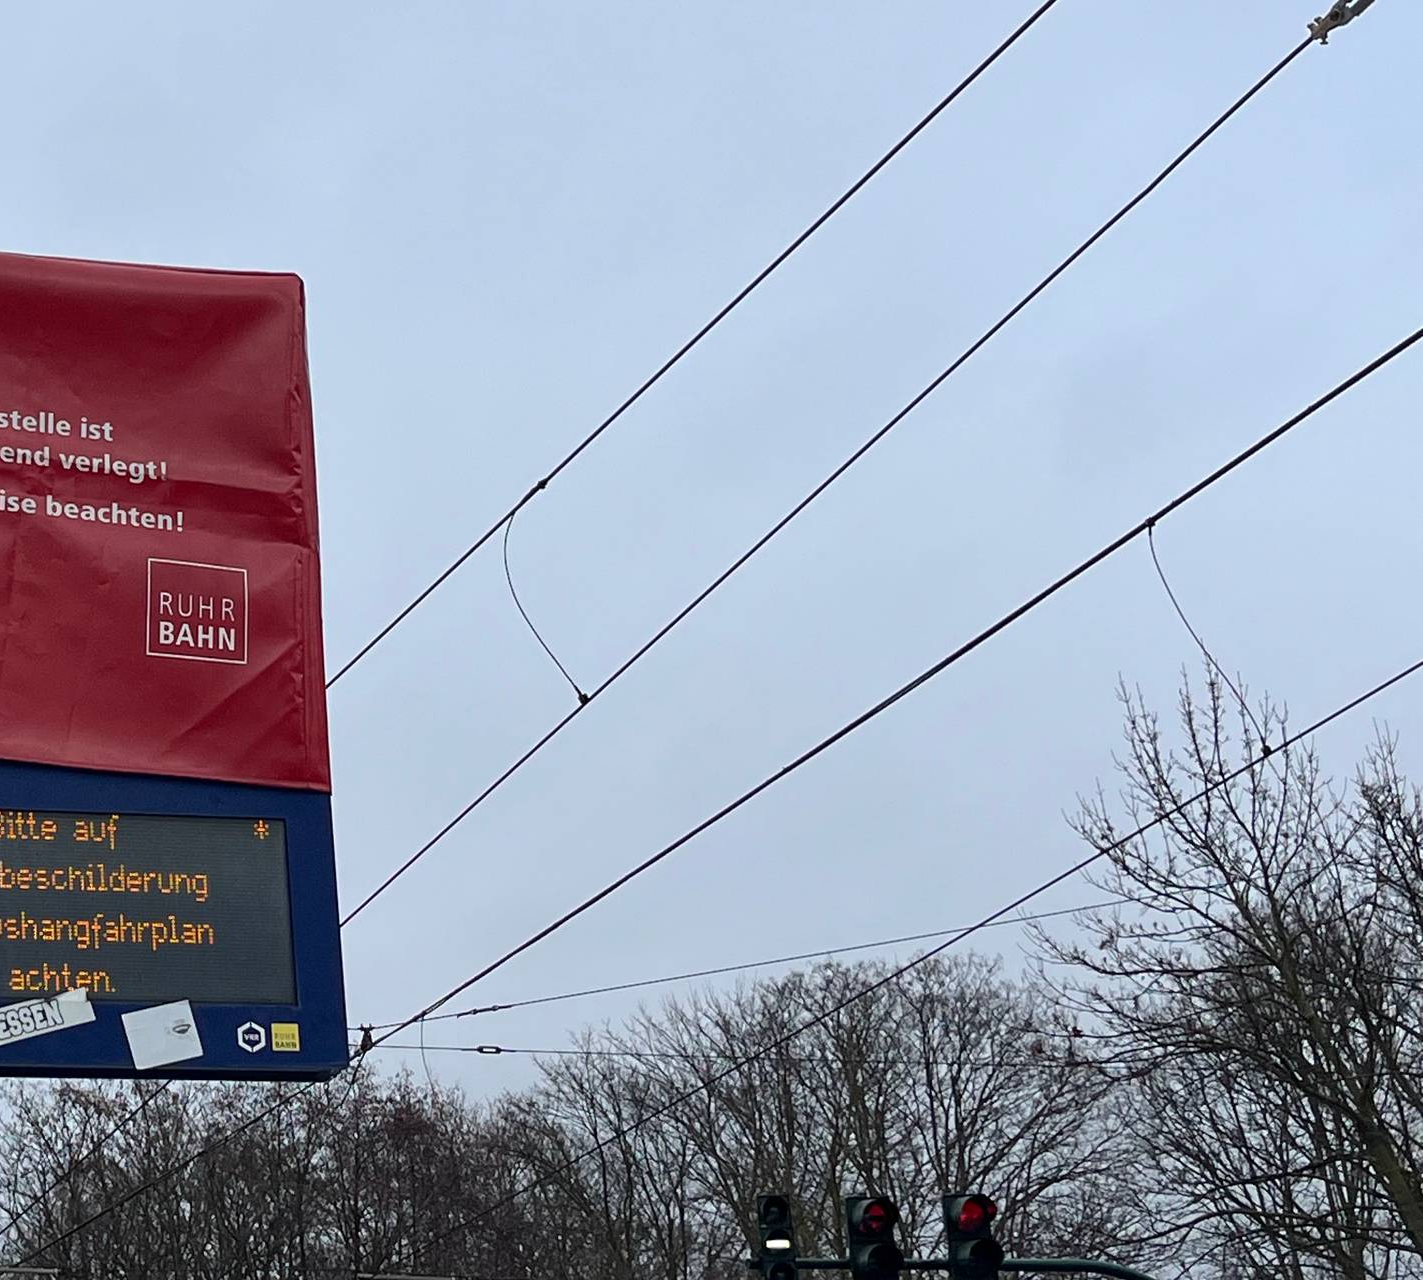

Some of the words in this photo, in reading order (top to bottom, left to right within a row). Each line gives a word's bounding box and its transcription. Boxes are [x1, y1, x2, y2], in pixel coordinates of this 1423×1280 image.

[80, 416, 114, 442] ist
[58, 453, 167, 484] verlegt!
[46, 494, 184, 533] beachten!
[159, 591, 235, 622] RUHR
[159, 621, 236, 651] BAHN
[74, 814, 119, 849] auf
[9, 962, 117, 993] achten.
